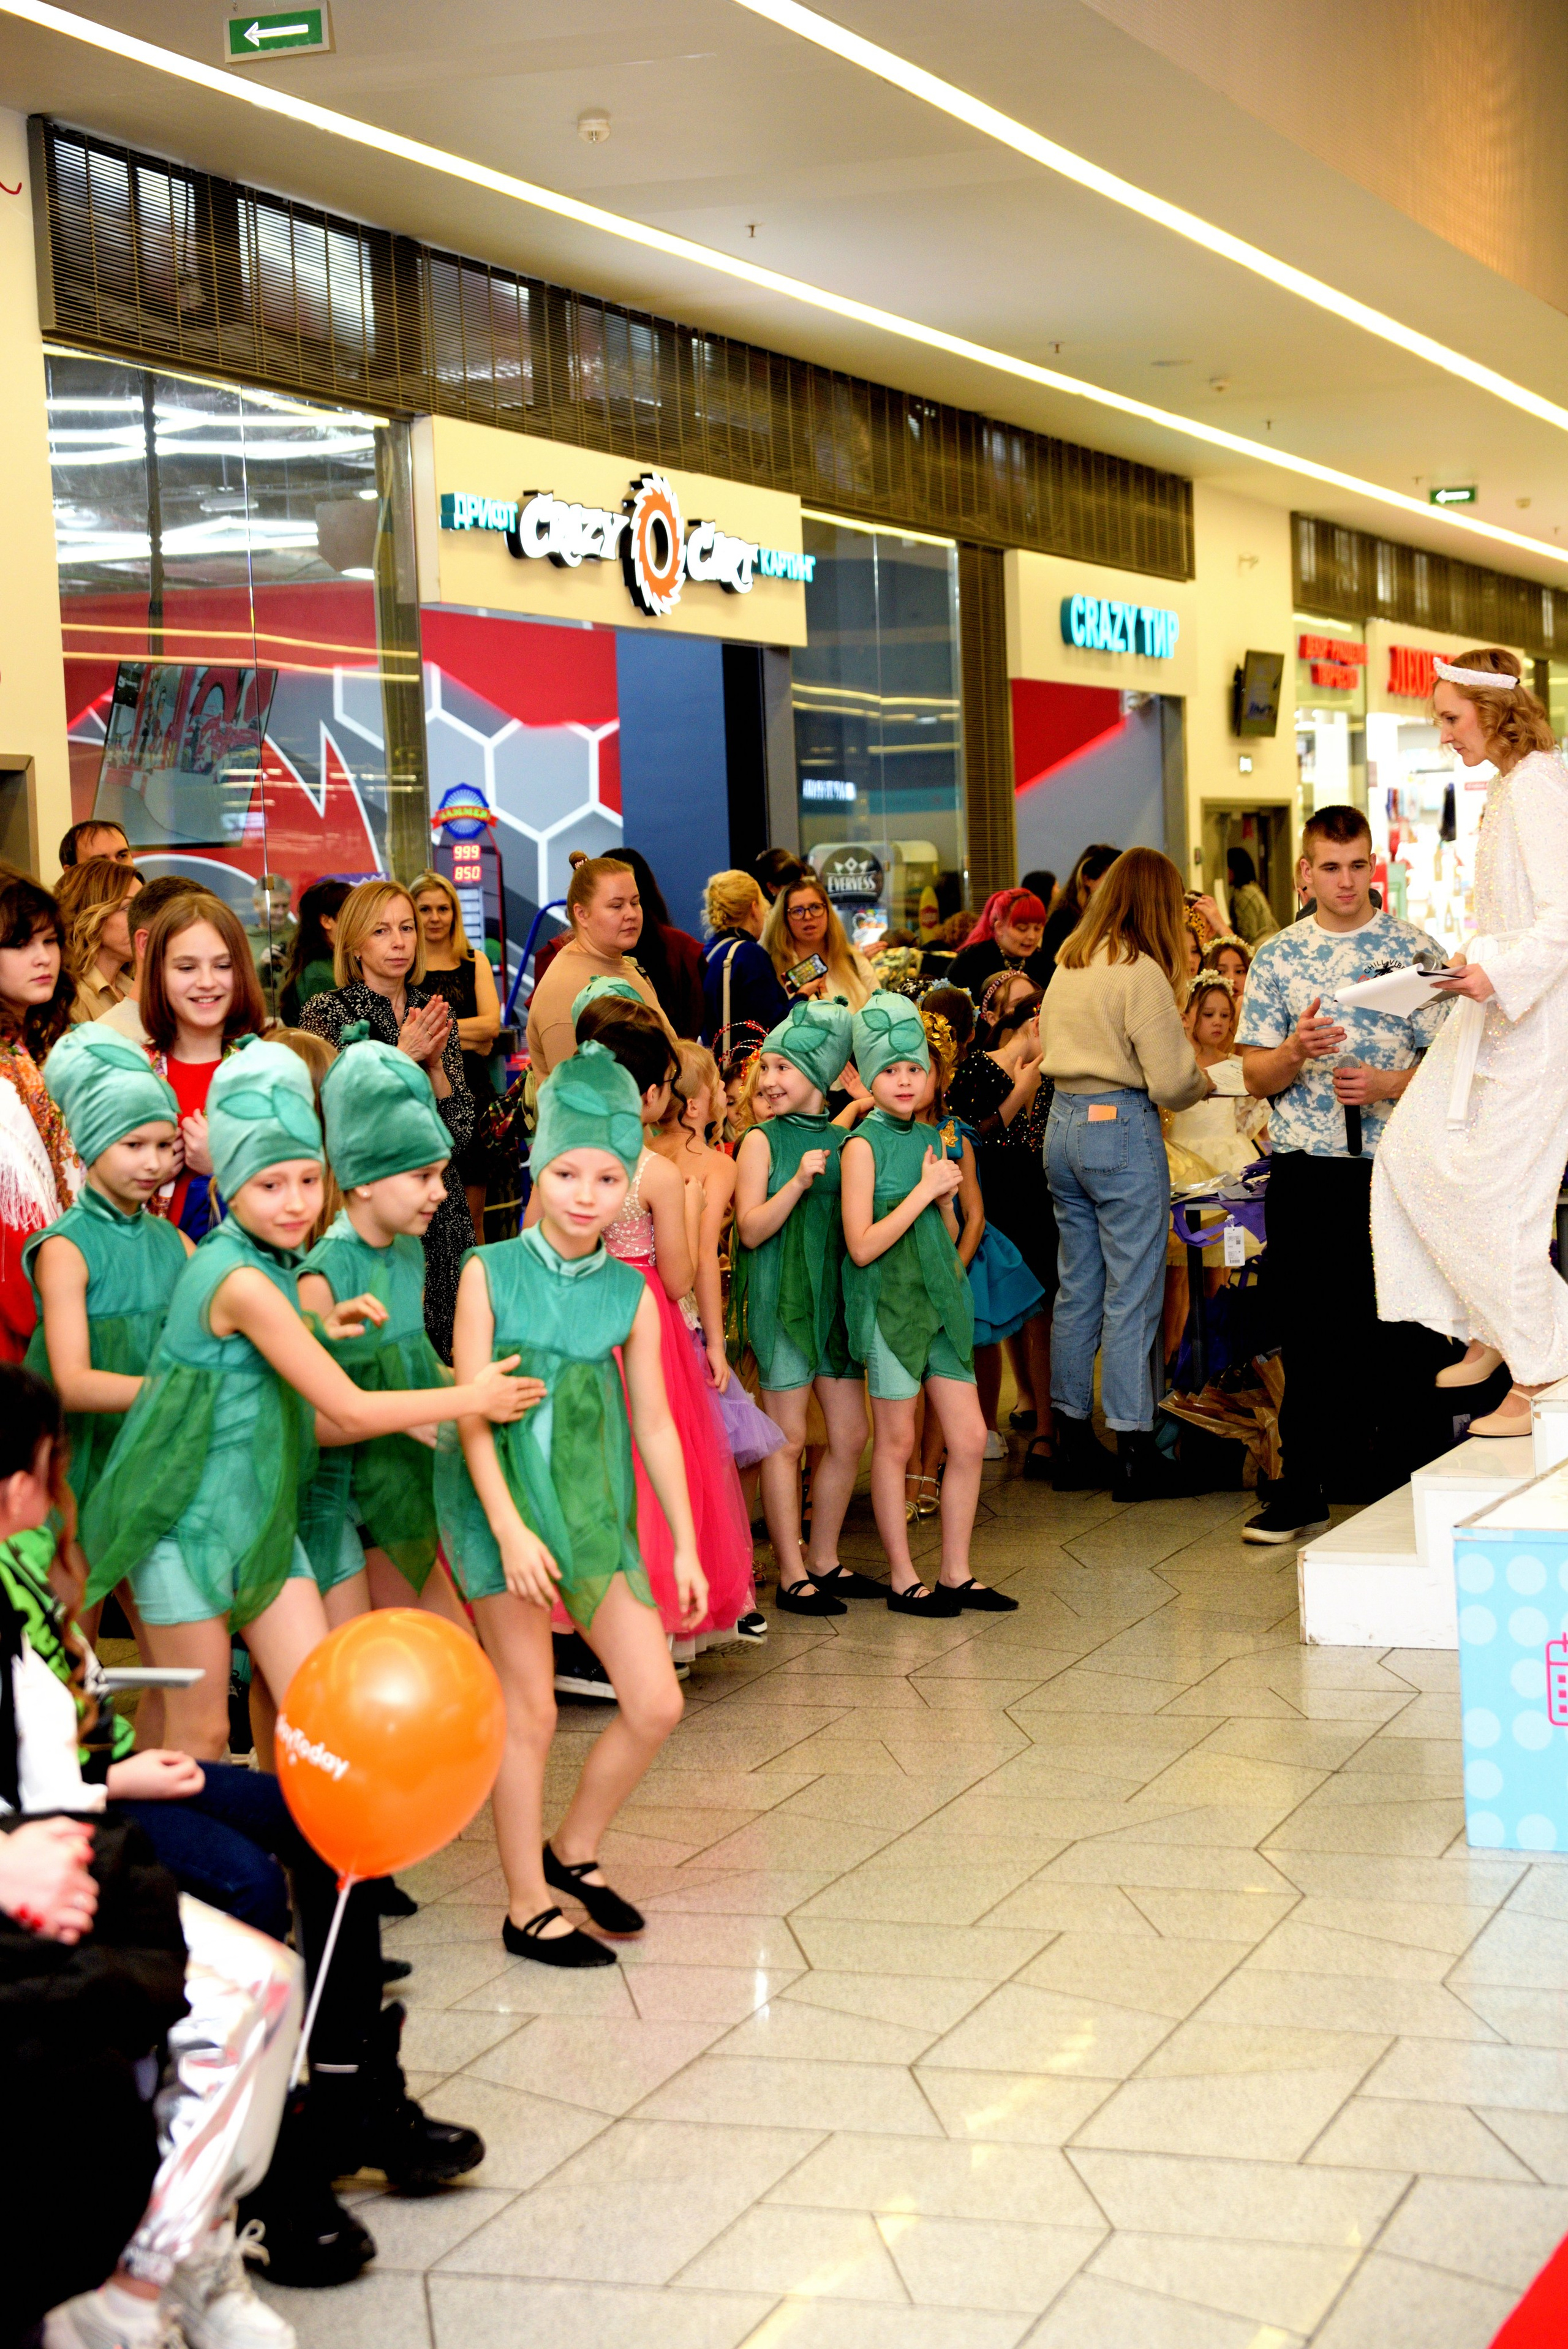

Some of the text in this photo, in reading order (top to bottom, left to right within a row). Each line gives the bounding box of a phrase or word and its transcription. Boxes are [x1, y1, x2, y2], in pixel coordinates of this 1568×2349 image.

[452, 491, 519, 534] ДРИФТ
[759, 548, 816, 583] КАРТИНГ
[1069, 592, 1180, 660] CRAZY ТИР
[453, 845, 480, 861] 999
[454, 865, 481, 881] 850
